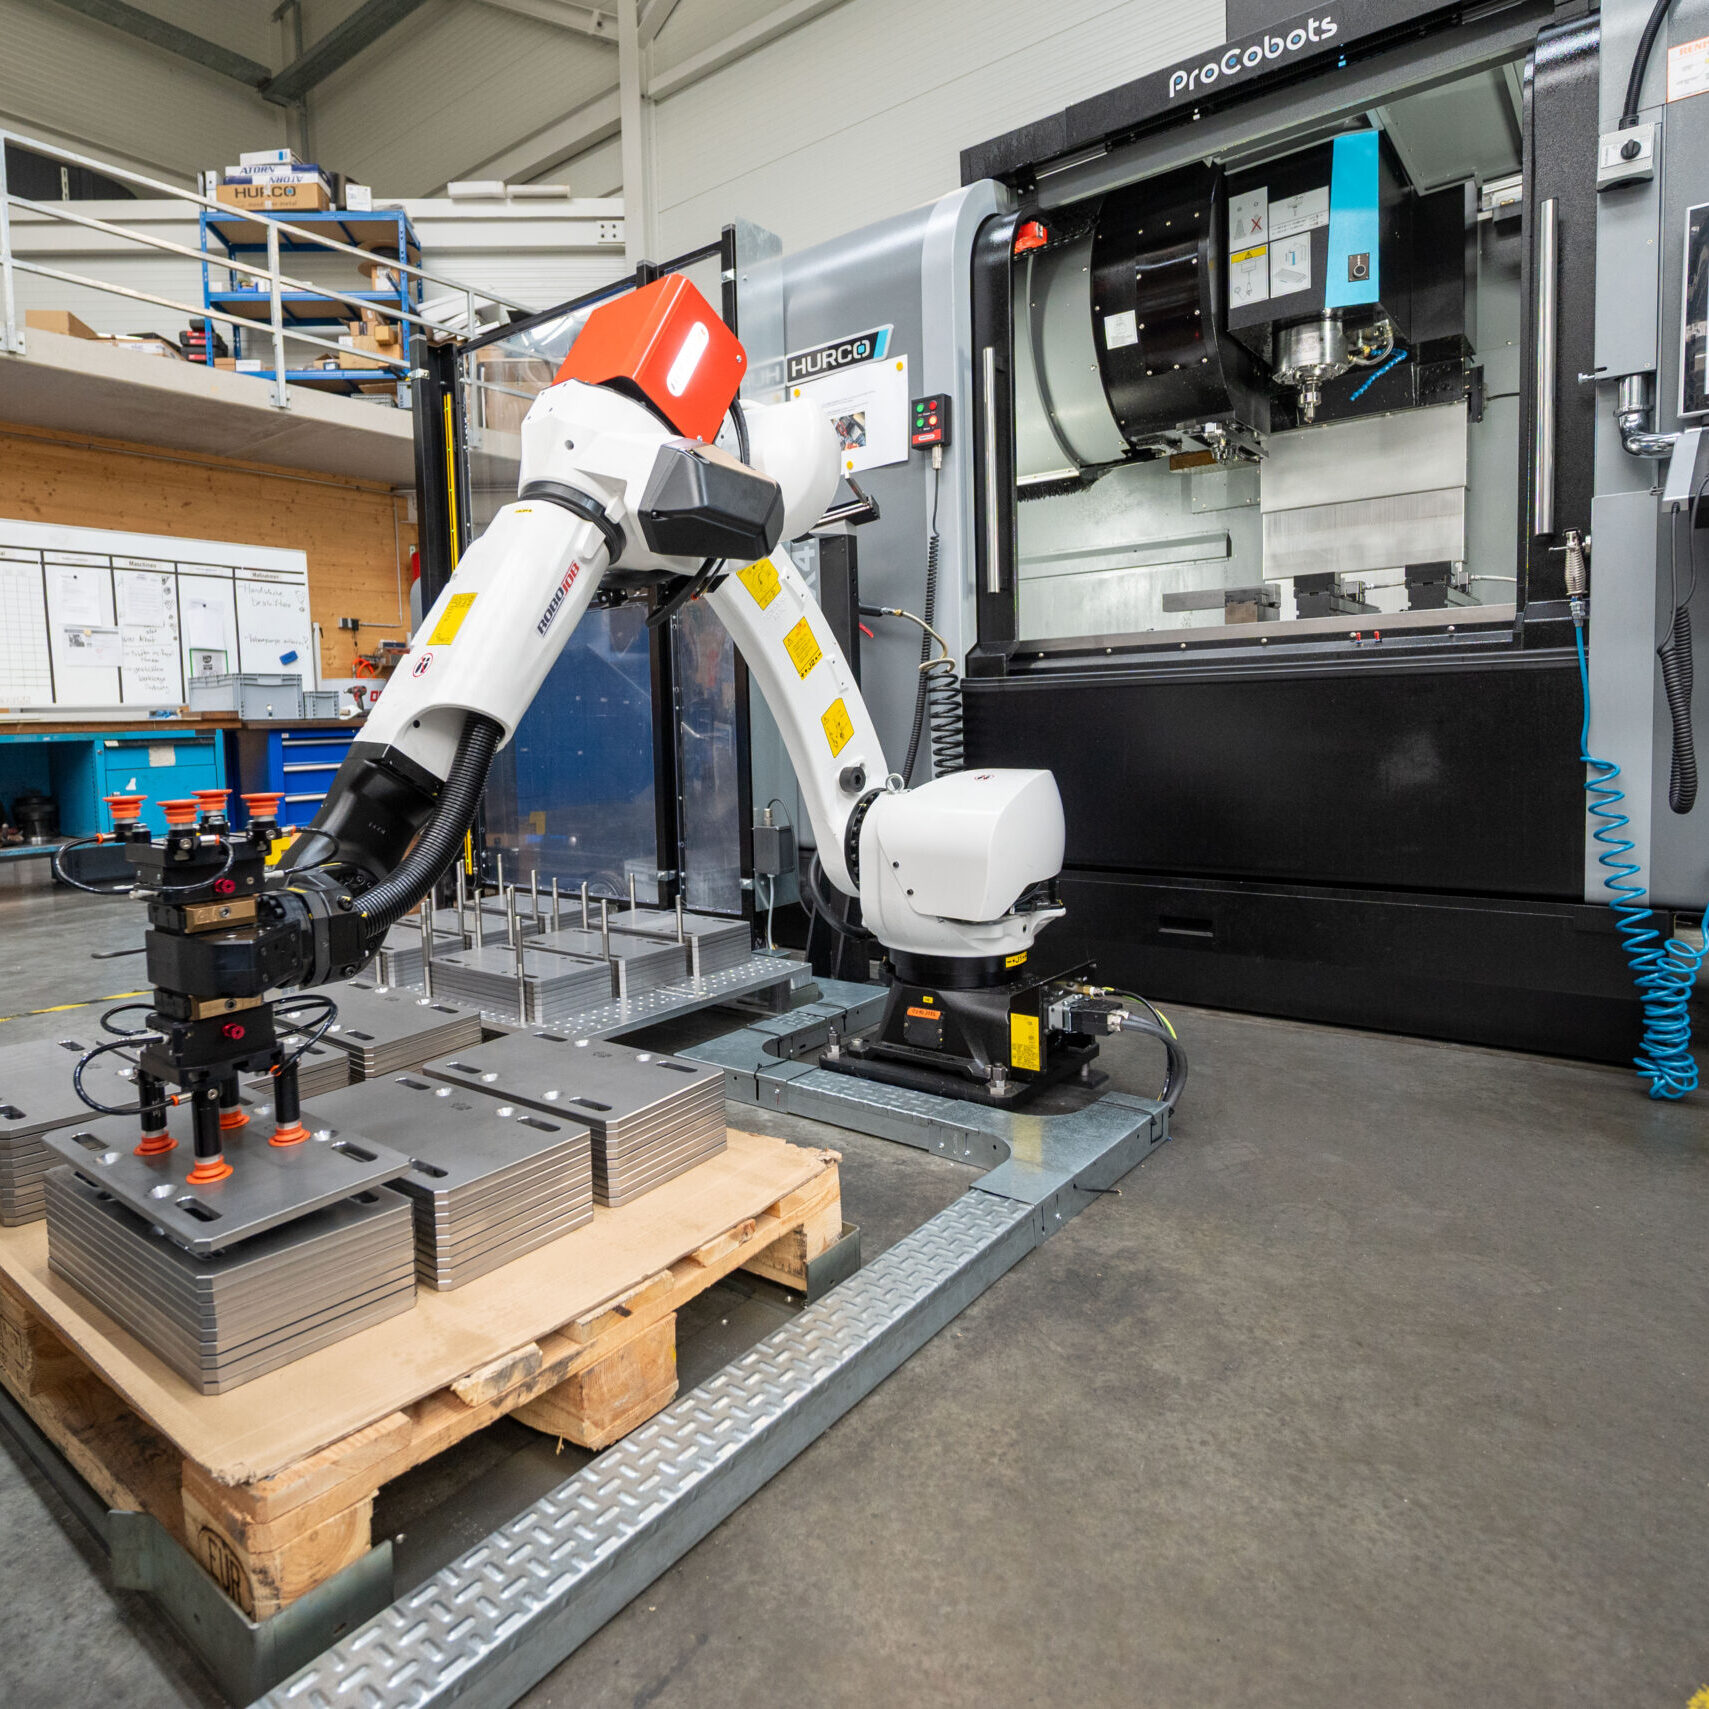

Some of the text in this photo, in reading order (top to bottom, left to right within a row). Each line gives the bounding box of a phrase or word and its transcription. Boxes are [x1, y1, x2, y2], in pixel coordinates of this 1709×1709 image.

[1169, 16, 1338, 98] ProCobots
[240, 166, 276, 175] ATORN
[791, 339, 871, 378] HURCO
[537, 562, 580, 634] ROBOJOB
